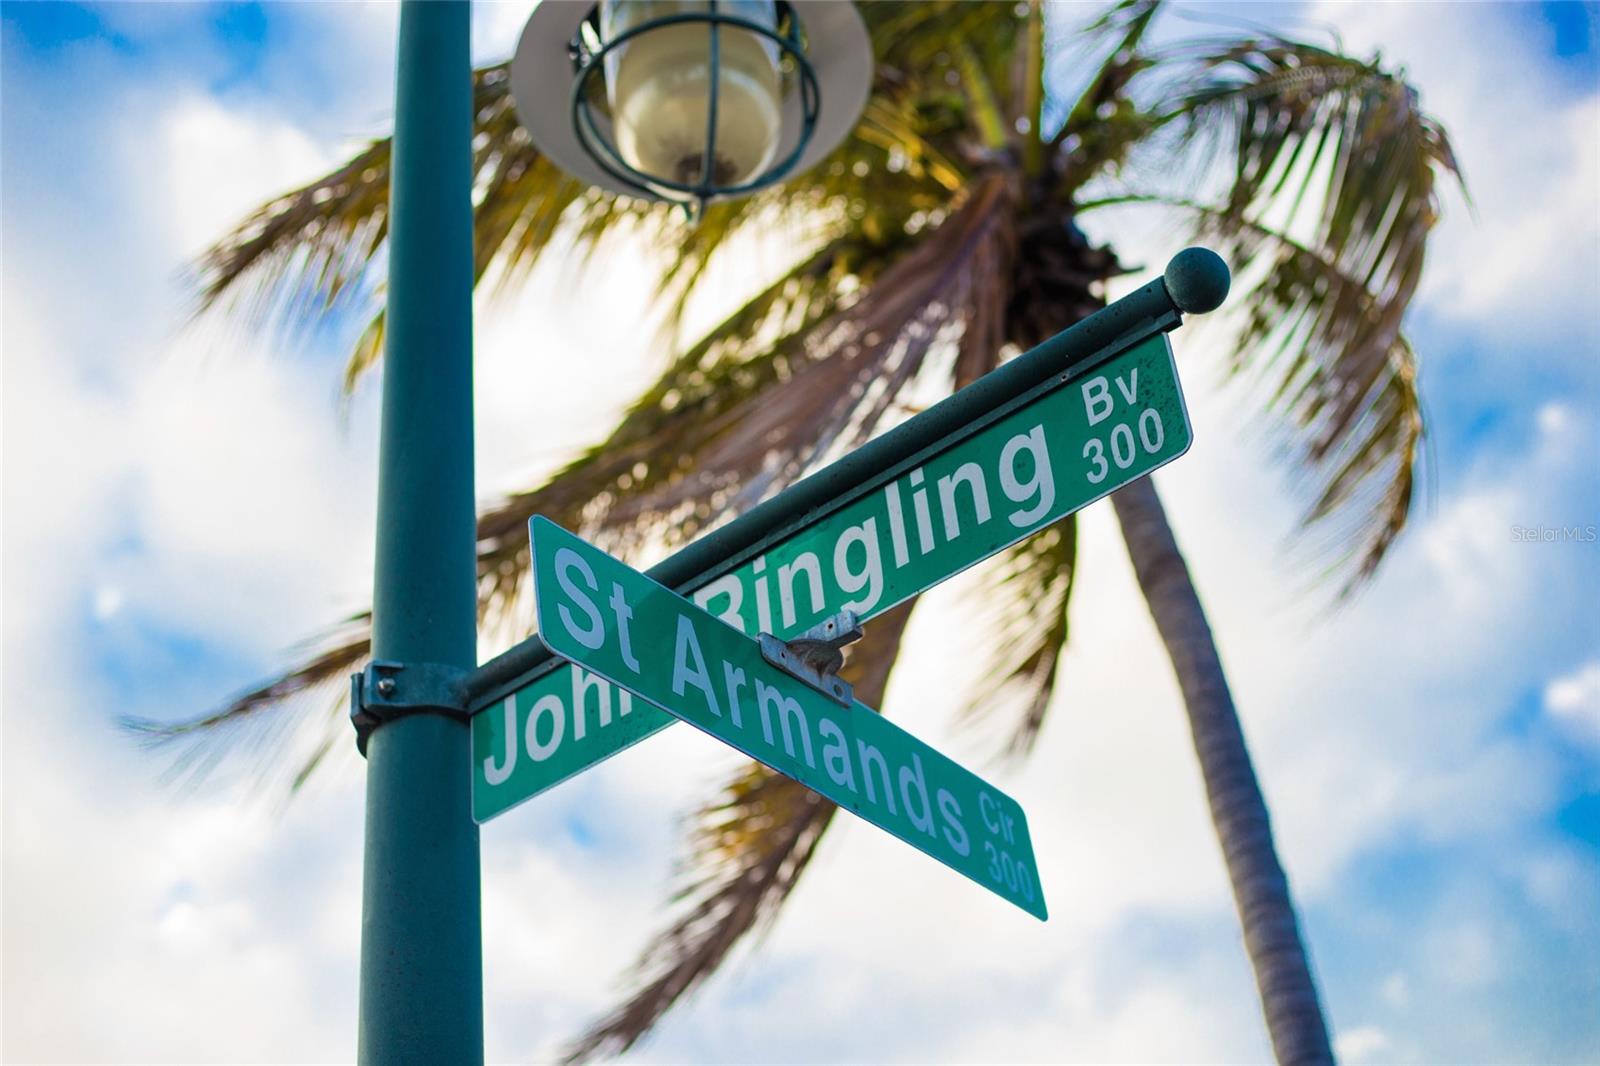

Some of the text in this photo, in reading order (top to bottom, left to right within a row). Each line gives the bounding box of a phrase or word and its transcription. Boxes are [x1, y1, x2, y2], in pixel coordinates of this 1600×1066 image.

[1081, 367, 1138, 427] Bv
[1082, 407, 1164, 484] 300
[483, 662, 633, 786] Joh
[554, 547, 970, 857] St Armands
[979, 791, 1015, 846] Cir
[984, 841, 1034, 902] 300
